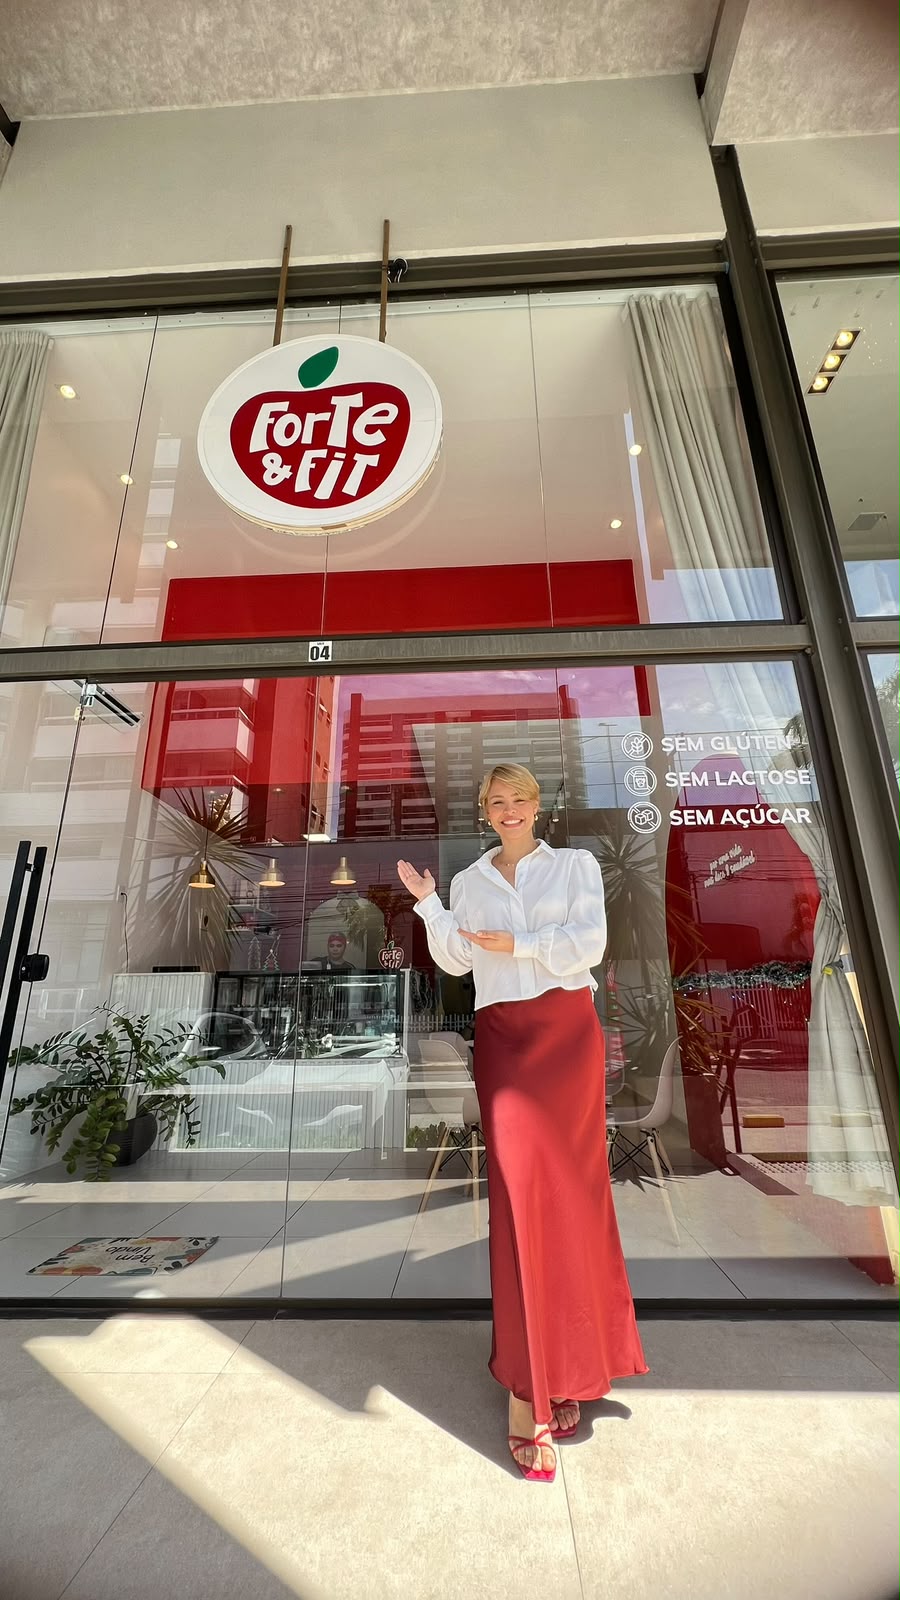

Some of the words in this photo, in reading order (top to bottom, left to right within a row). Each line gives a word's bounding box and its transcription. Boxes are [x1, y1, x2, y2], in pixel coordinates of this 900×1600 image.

[261, 452, 293, 486] &
[310, 645, 330, 661] 04
[661, 736, 704, 753] SEM
[710, 732, 792, 752] GLÚTEN
[665, 771, 709, 787] SEM
[714, 769, 812, 786] LACTOSE
[669, 809, 714, 826] SEM
[720, 803, 812, 829] AÇÚCAR
[105, 1246, 152, 1255] Vindo
[115, 1254, 155, 1263] Bem
